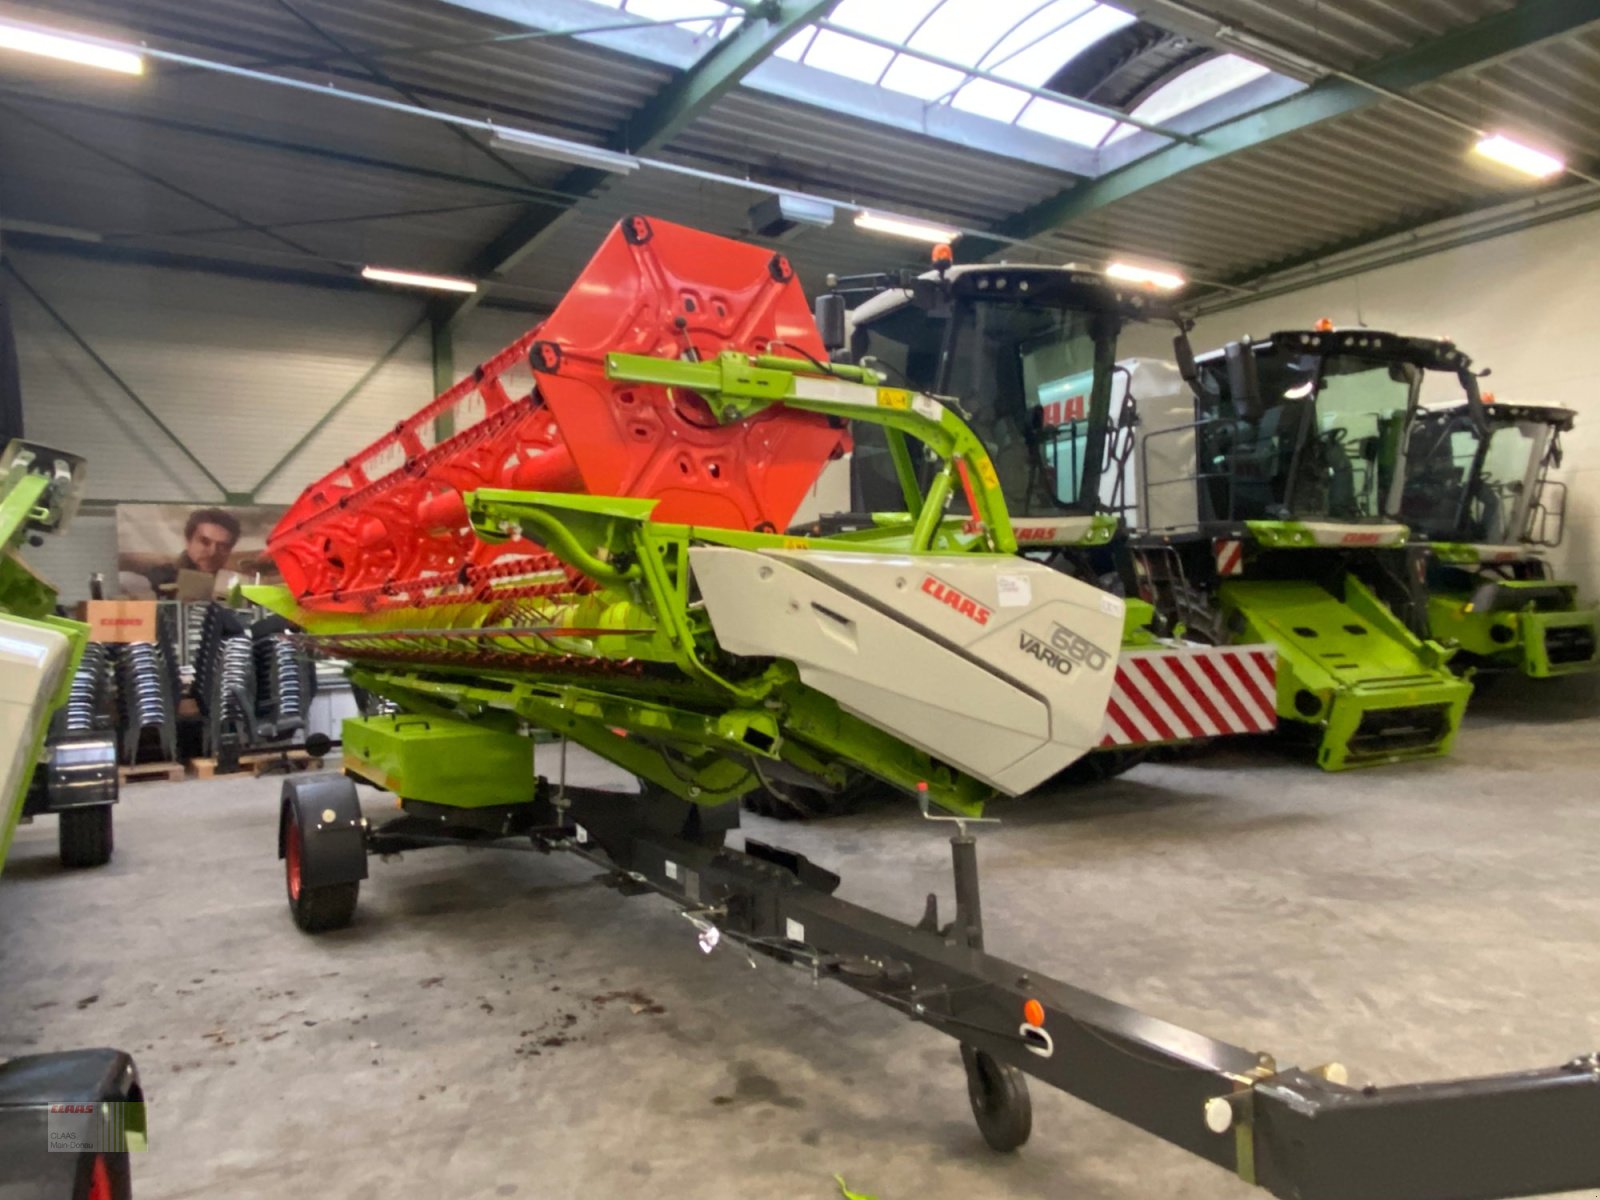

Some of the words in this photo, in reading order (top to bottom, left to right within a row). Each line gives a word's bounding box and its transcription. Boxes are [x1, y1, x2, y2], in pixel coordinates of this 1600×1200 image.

[921, 576, 990, 626] CLAAS
[1019, 633, 1073, 675] VARIO
[1051, 626, 1107, 672] 680
